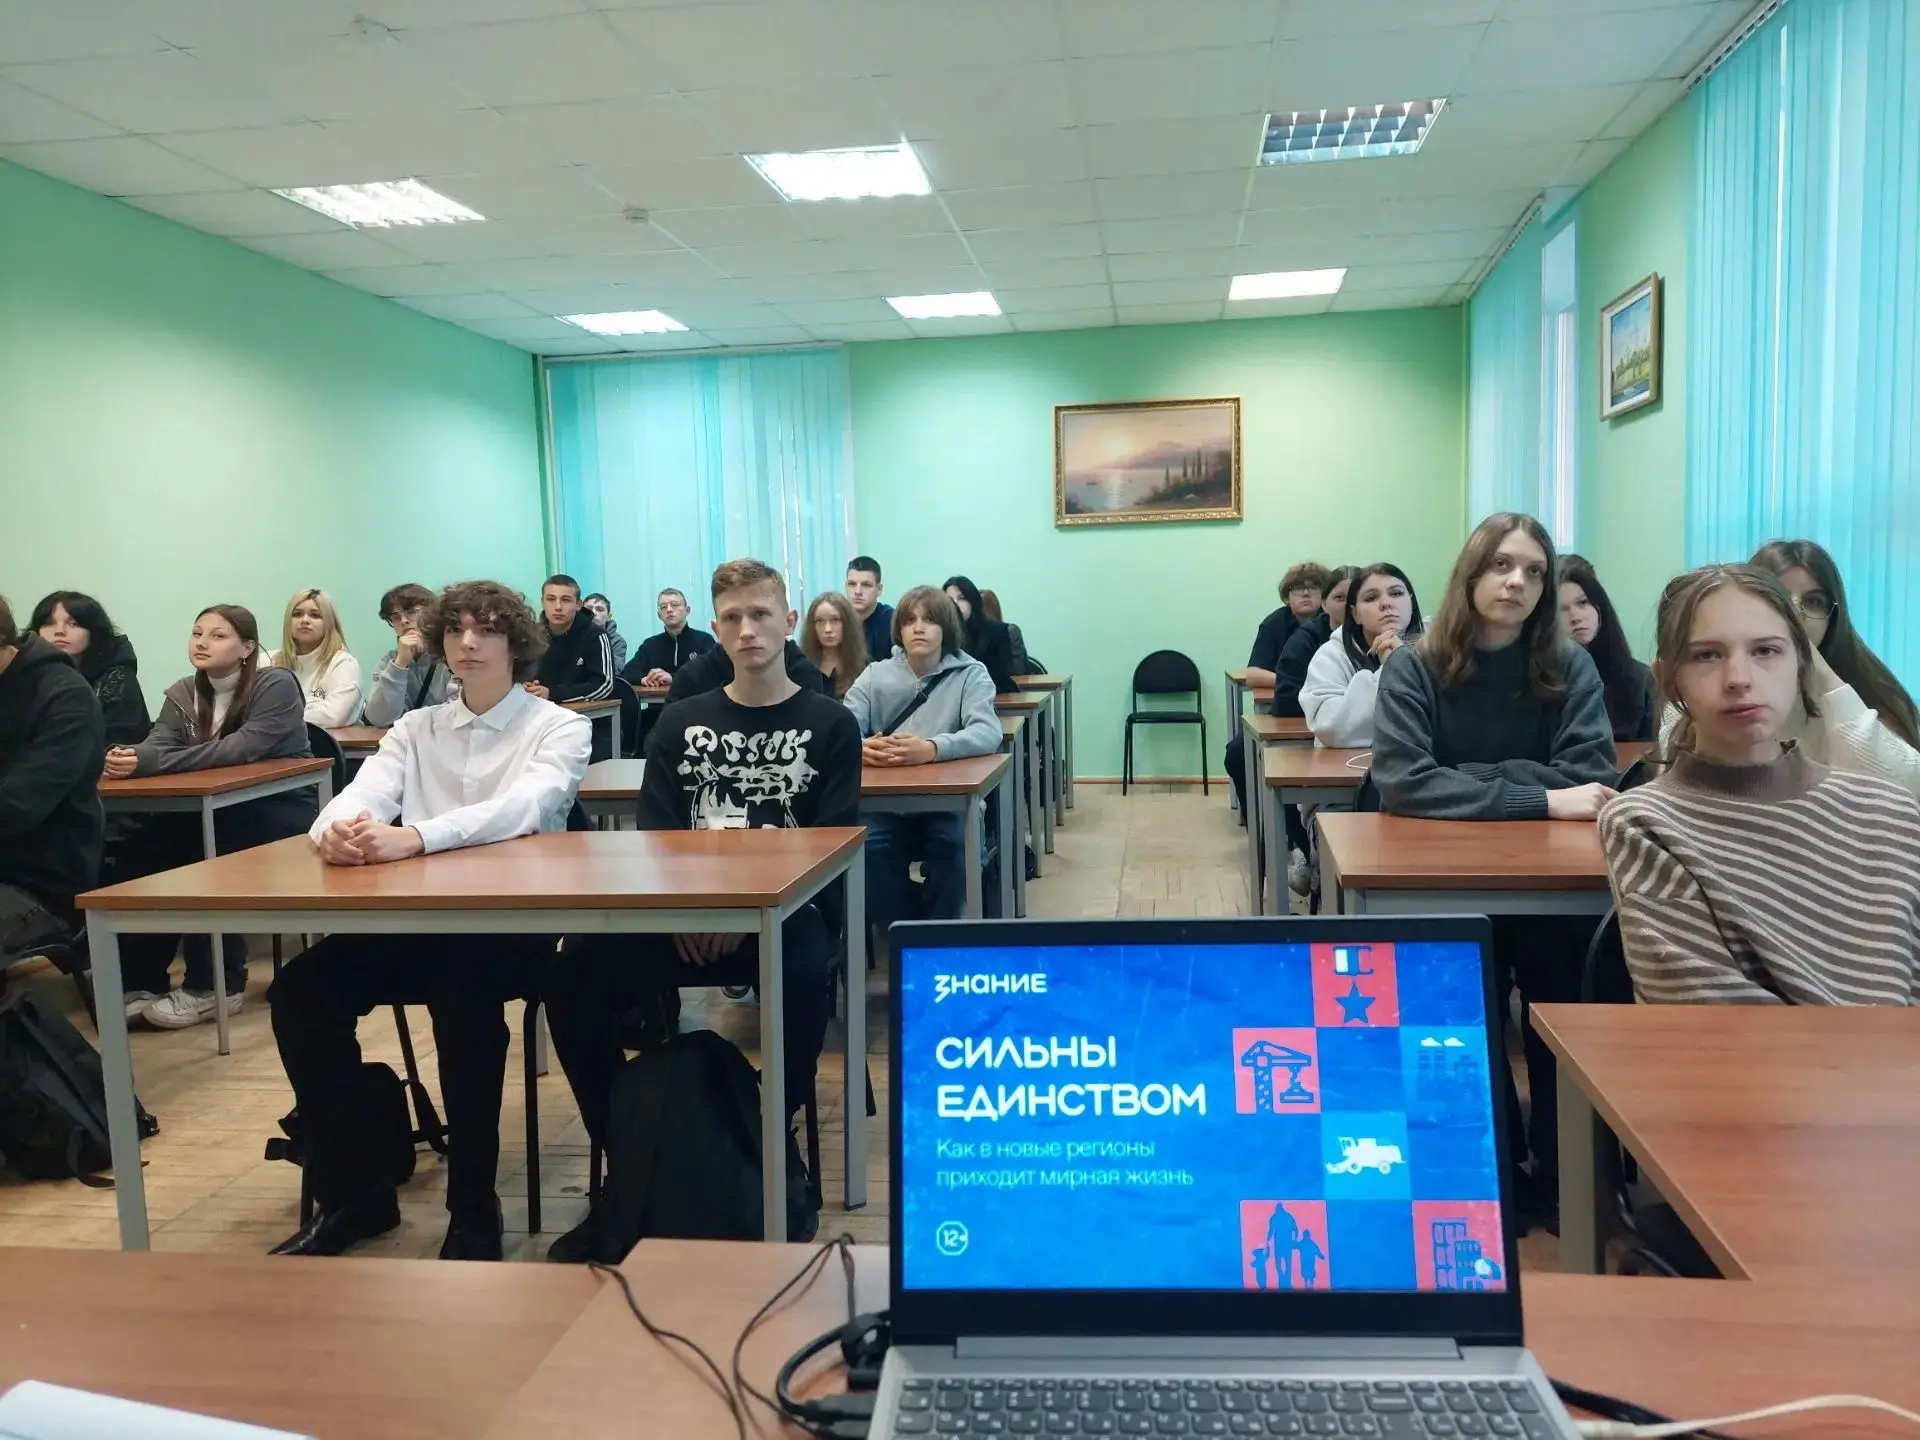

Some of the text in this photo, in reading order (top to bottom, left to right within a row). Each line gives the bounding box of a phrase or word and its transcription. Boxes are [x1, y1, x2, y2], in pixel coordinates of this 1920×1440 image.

[935, 1035, 1117, 1069] СИЛЬНЫ
[937, 1082, 1207, 1121] ЕДИНСТВОМ
[936, 1138, 1155, 1161] Как в новые регионы
[936, 1168, 1194, 1191] приходит мирная жизнь
